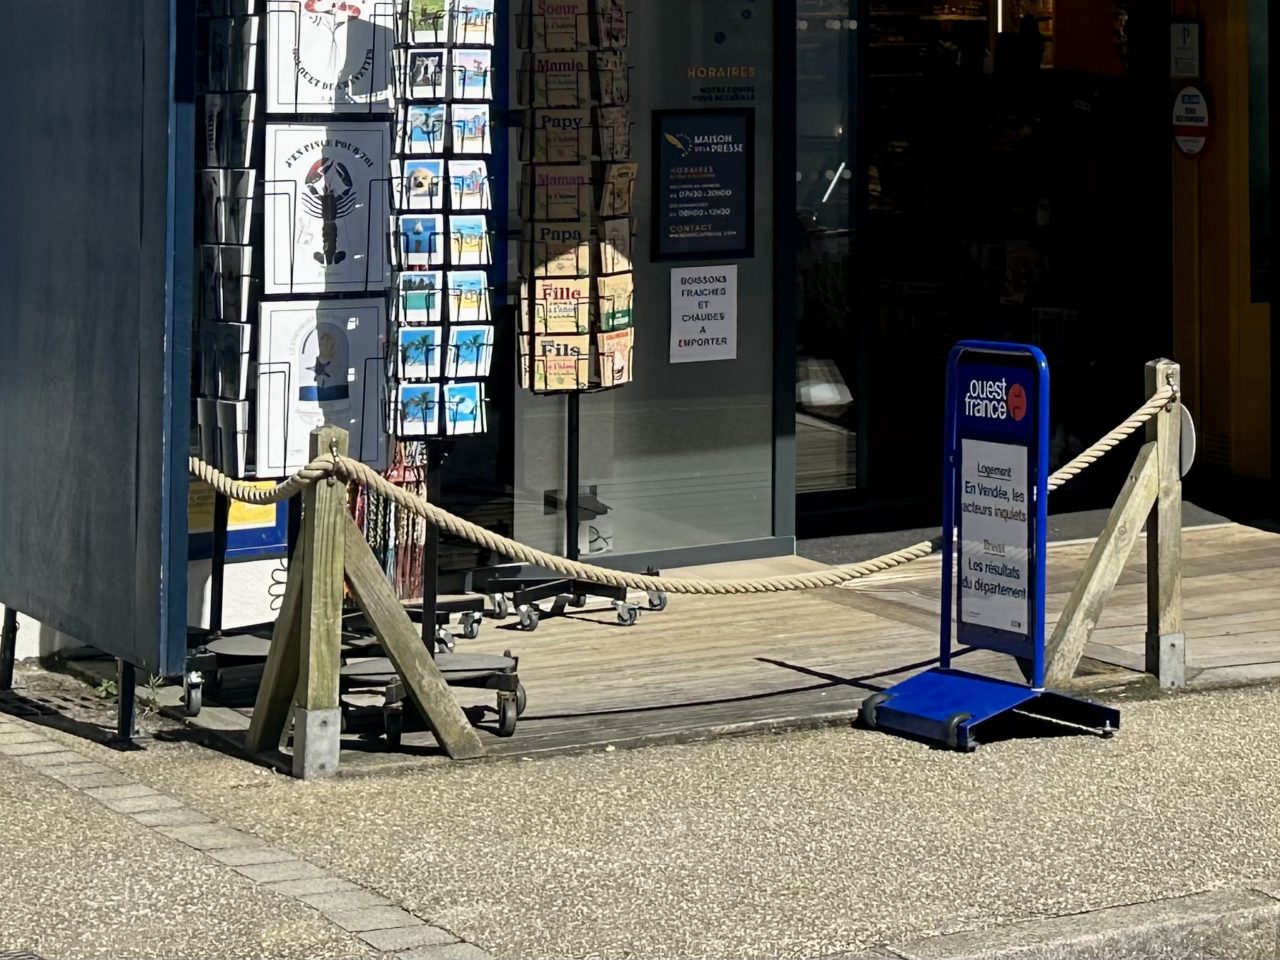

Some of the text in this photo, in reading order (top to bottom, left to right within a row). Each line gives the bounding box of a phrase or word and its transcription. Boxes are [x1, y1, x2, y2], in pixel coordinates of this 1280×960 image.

[537, 59, 584, 73] Mamie
[688, 66, 756, 78] HORAIRES
[542, 115, 582, 130] Papy
[694, 134, 733, 144] MAISON
[711, 143, 744, 153] PRESSE
[538, 175, 585, 186] Maman
[540, 228, 582, 242] Papa
[670, 224, 712, 233] CONTACT
[681, 276, 727, 285] BOISSONS
[543, 287, 581, 301] Fille
[698, 301, 710, 309] ET
[682, 313, 725, 322] CHAUDES
[542, 343, 581, 356] Fils
[678, 338, 727, 348] EMPORTER
[970, 377, 1007, 400] ouest
[965, 393, 1007, 419] france
[978, 461, 1012, 477] Logement
[965, 481, 1025, 502] En Vendée, les
[962, 501, 1026, 522] acteurs inquiets
[969, 557, 1020, 580] Les résultats
[962, 576, 1026, 599] du département
